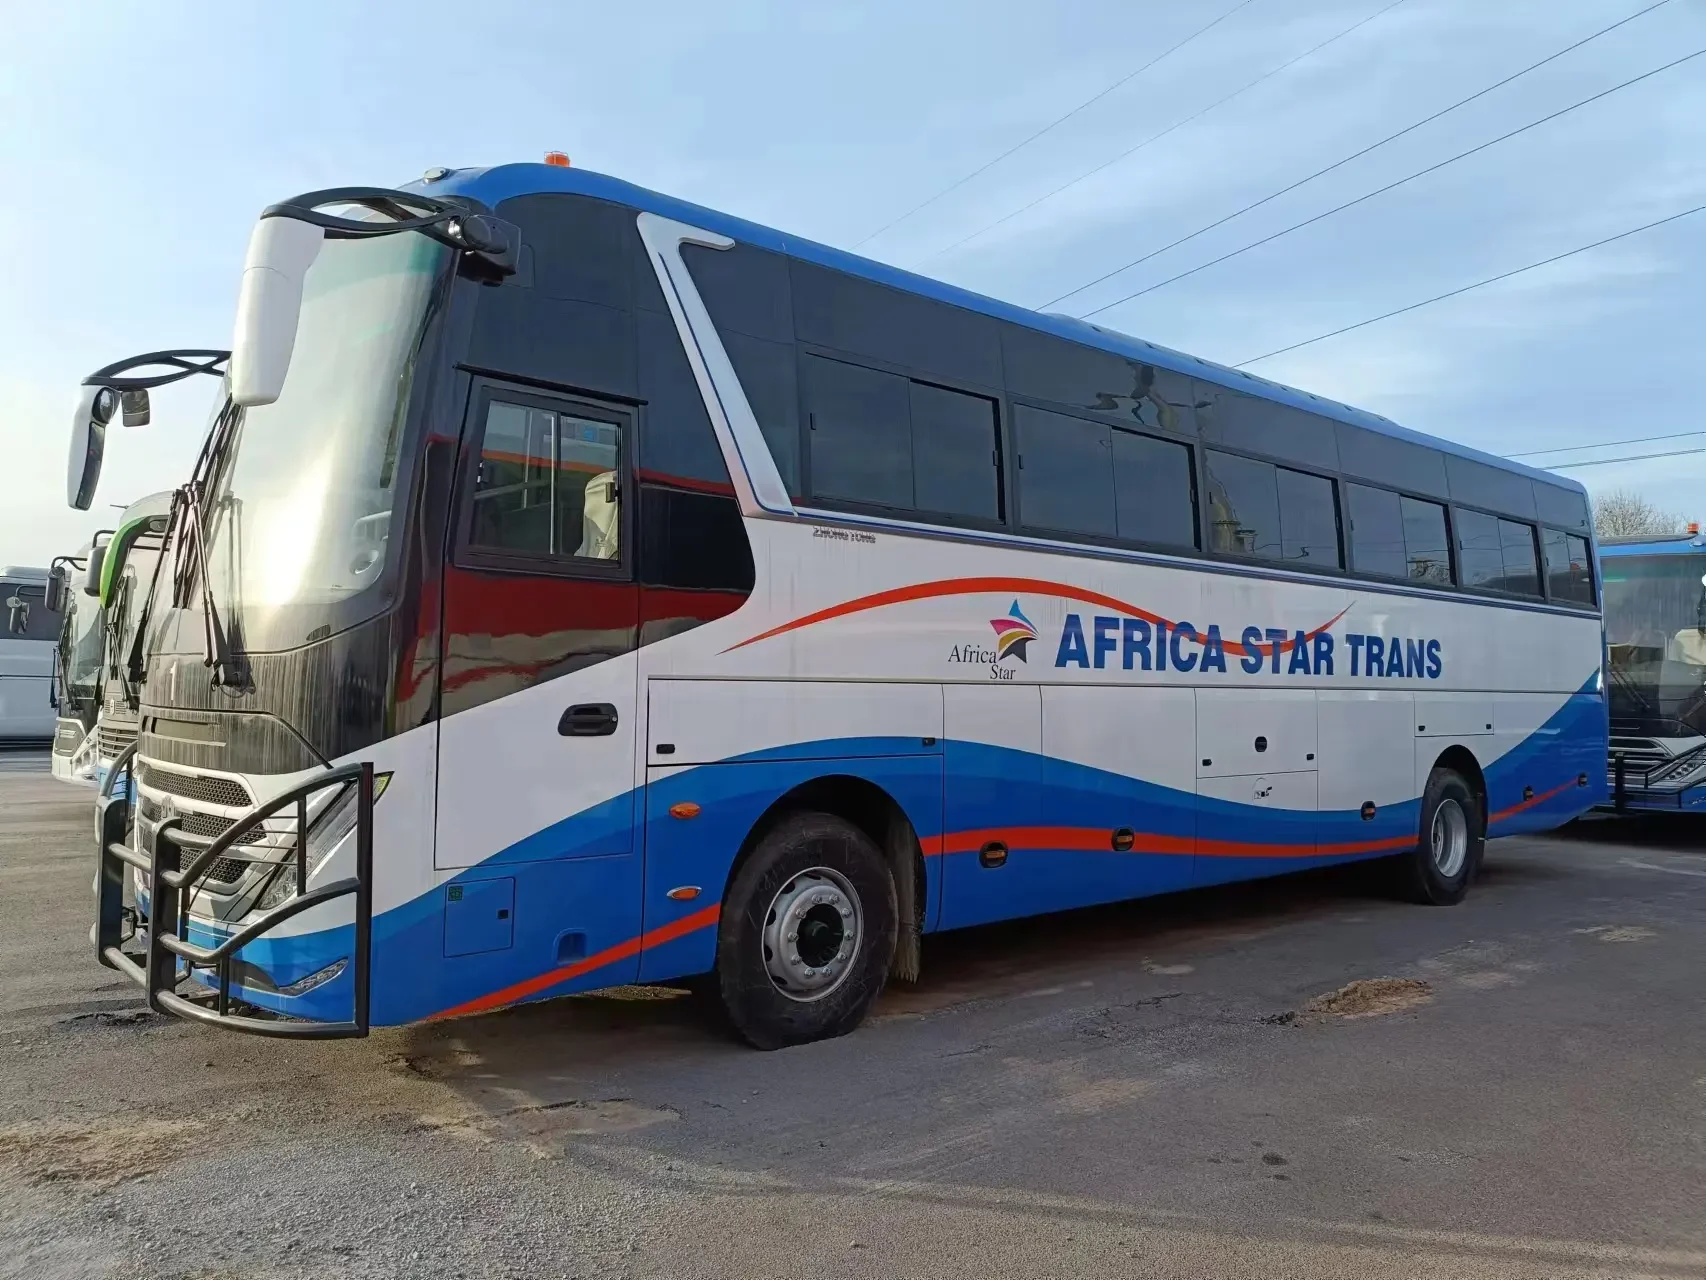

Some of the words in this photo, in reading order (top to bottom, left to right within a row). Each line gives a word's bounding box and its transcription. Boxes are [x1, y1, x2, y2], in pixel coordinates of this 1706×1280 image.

[948, 643, 997, 664] Africa
[1055, 614, 1227, 672] AFRICA
[1240, 626, 1335, 676] STAR
[1346, 633, 1442, 679] TRANS
[990, 664, 1016, 680] Star
